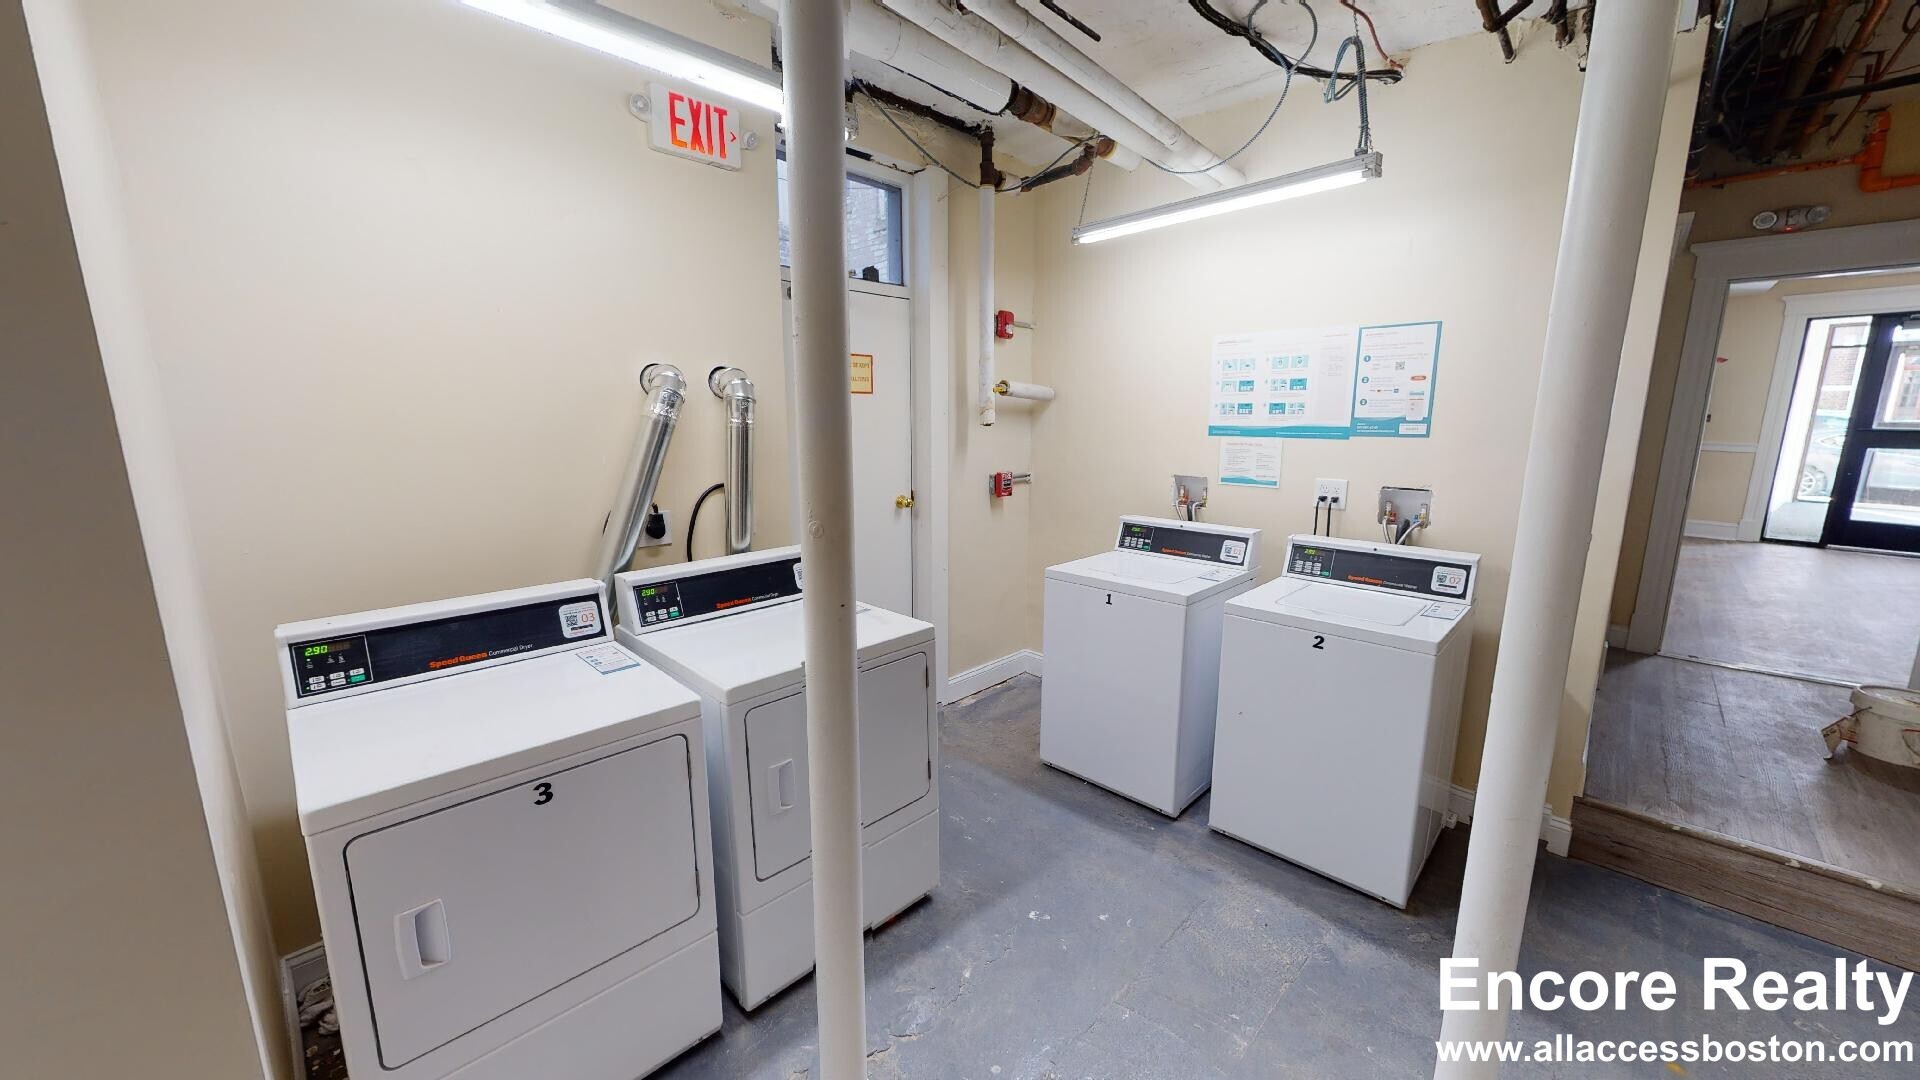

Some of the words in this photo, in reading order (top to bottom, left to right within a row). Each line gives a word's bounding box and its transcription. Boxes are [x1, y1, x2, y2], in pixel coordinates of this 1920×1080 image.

[669, 91, 728, 159] EXIT
[1106, 594, 1112, 605] 1
[581, 612, 595, 623] 03
[1312, 636, 1324, 649] 2
[429, 656, 459, 669] Speed
[533, 782, 553, 805] 3
